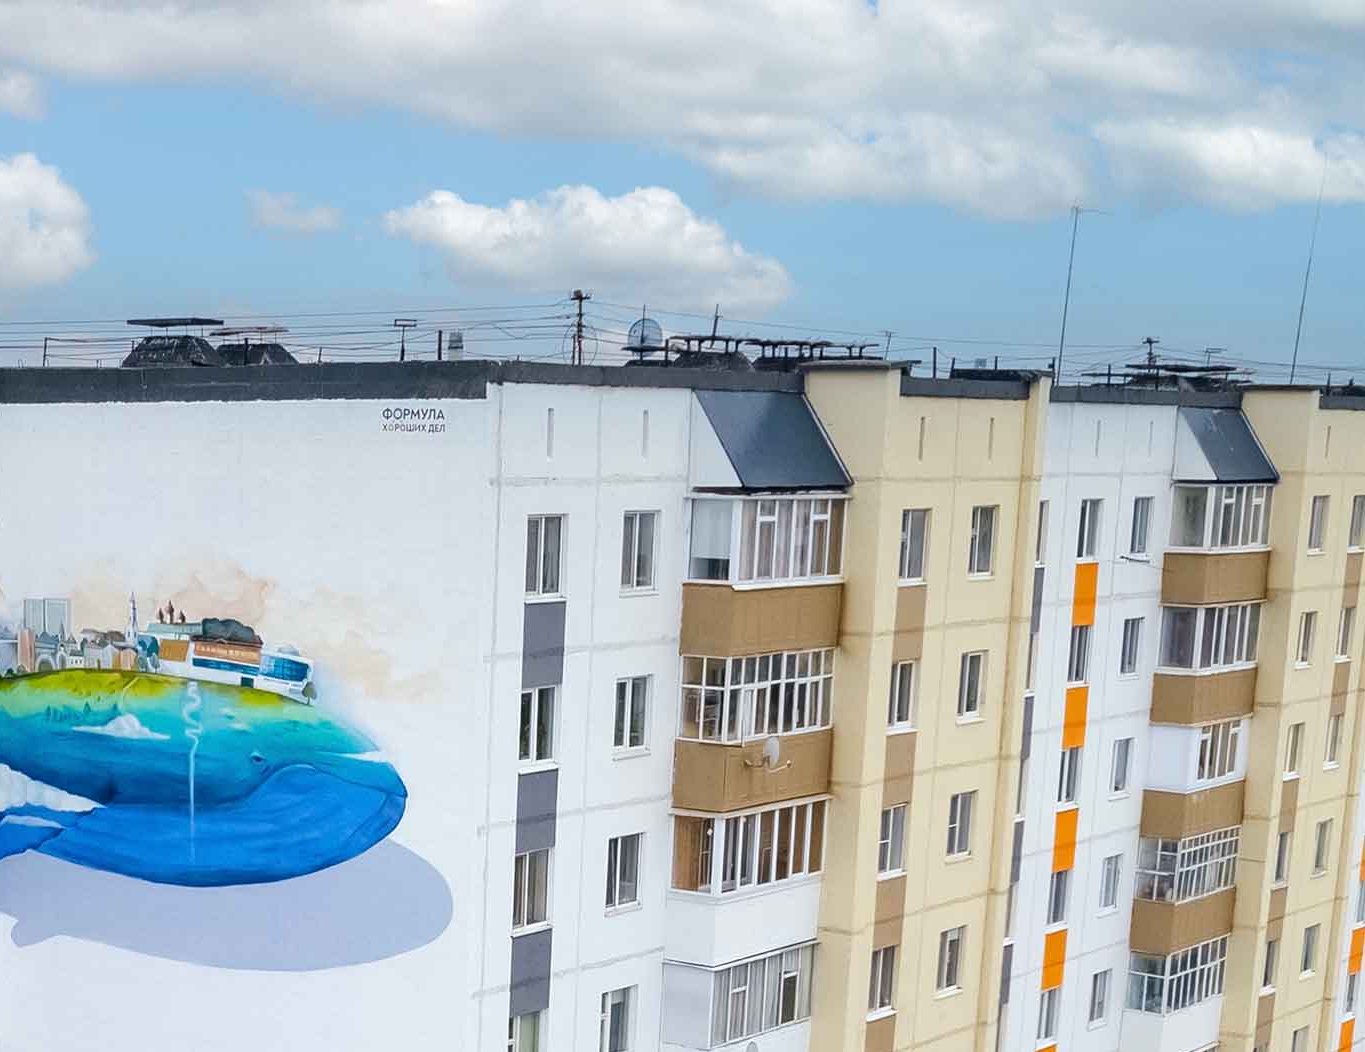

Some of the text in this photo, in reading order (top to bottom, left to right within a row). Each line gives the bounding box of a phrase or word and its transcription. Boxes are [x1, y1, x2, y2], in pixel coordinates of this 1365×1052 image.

[382, 407, 445, 420] ФОРМУЛА
[382, 423, 446, 433] ХОРОШИХ ДЕЛ
